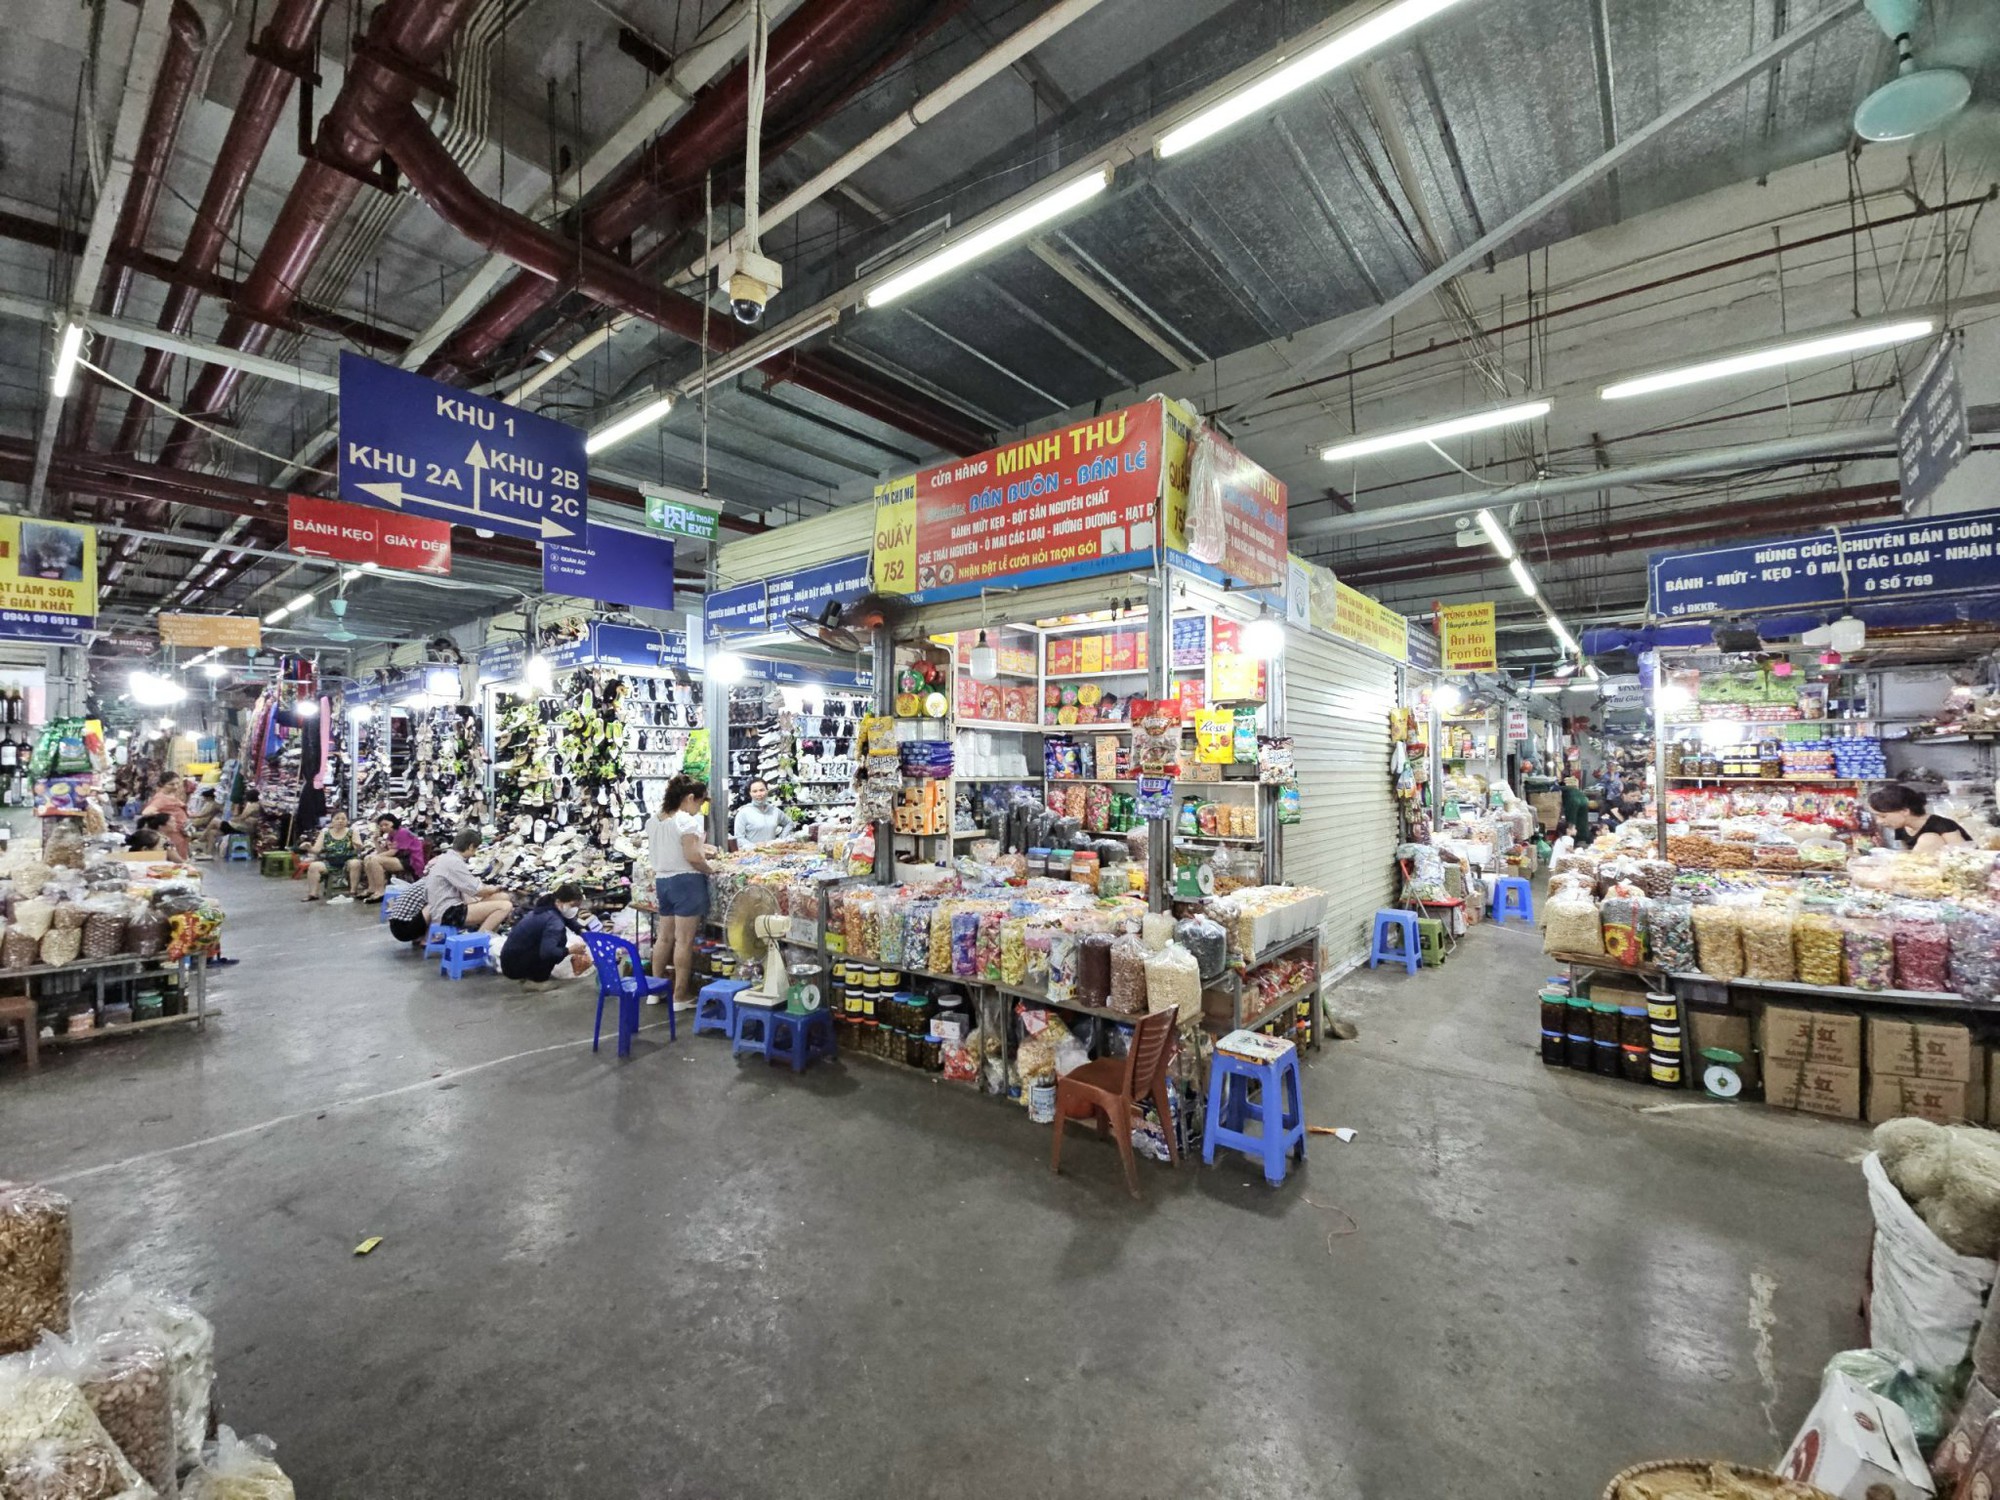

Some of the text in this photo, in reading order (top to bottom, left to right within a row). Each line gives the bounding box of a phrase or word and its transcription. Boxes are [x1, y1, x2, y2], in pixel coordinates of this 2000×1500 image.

[437, 395, 515, 438] KHU 1
[349, 442, 463, 491] KHU 2A
[931, 411, 1128, 488] CỬA HÀNG MINH THƯ
[490, 449, 580, 491] KHU 2B
[1007, 473, 1059, 504] BUÔN
[1124, 441, 1147, 472] LẺ
[490, 478, 580, 517] KHU 2C
[951, 524, 971, 539] BÁNH
[972, 518, 989, 533] MỨT
[990, 515, 1005, 532] KẸO
[1012, 508, 1027, 526] BỘT
[1029, 503, 1047, 521] SẮN
[1049, 495, 1083, 516] NGUYÊN
[1085, 486, 1110, 508] CHẤT
[293, 519, 374, 542] BÁNH KẸO
[384, 534, 447, 553] GIÀY DÉP
[688, 523, 712, 537] EXIT
[876, 518, 913, 552] QUẦY
[933, 546, 948, 561] THÁI
[949, 540, 978, 559] NGUYÊN
[992, 535, 1007, 550] MAI
[1008, 530, 1025, 546] CÁC
[1027, 526, 1045, 543] LOẠI
[1053, 517, 1082, 536] HƯỚNG
[1085, 510, 1117, 530] DƯƠNG
[1125, 503, 1145, 522] HẠT
[1755, 522, 1993, 564] HÙNG CÚC: CHUYÊN BÁN BUÔN
[883, 559, 905, 582] 752
[958, 563, 980, 579] NHẬN
[981, 560, 996, 576] ĐẶT
[1009, 553, 1030, 569] CƯỚI
[1032, 548, 1048, 565] HỎI
[1050, 545, 1076, 562] TRỌN
[1077, 540, 1097, 556] GÓI
[1665, 577, 1704, 592] BÁNH
[1717, 570, 1748, 586] MỨT
[1762, 567, 1791, 582] KẸO
[1807, 562, 1816, 576] Ô
[1856, 553, 1890, 570] CÁC
[1893, 550, 1930, 566] LOẠI
[1945, 543, 1992, 560] NHẬN
[48, 586, 74, 599] SỮA
[1864, 573, 1933, 591] Ô SỐ 769
[2, 612, 31, 622] 0944
[50, 615, 79, 626] 6918
